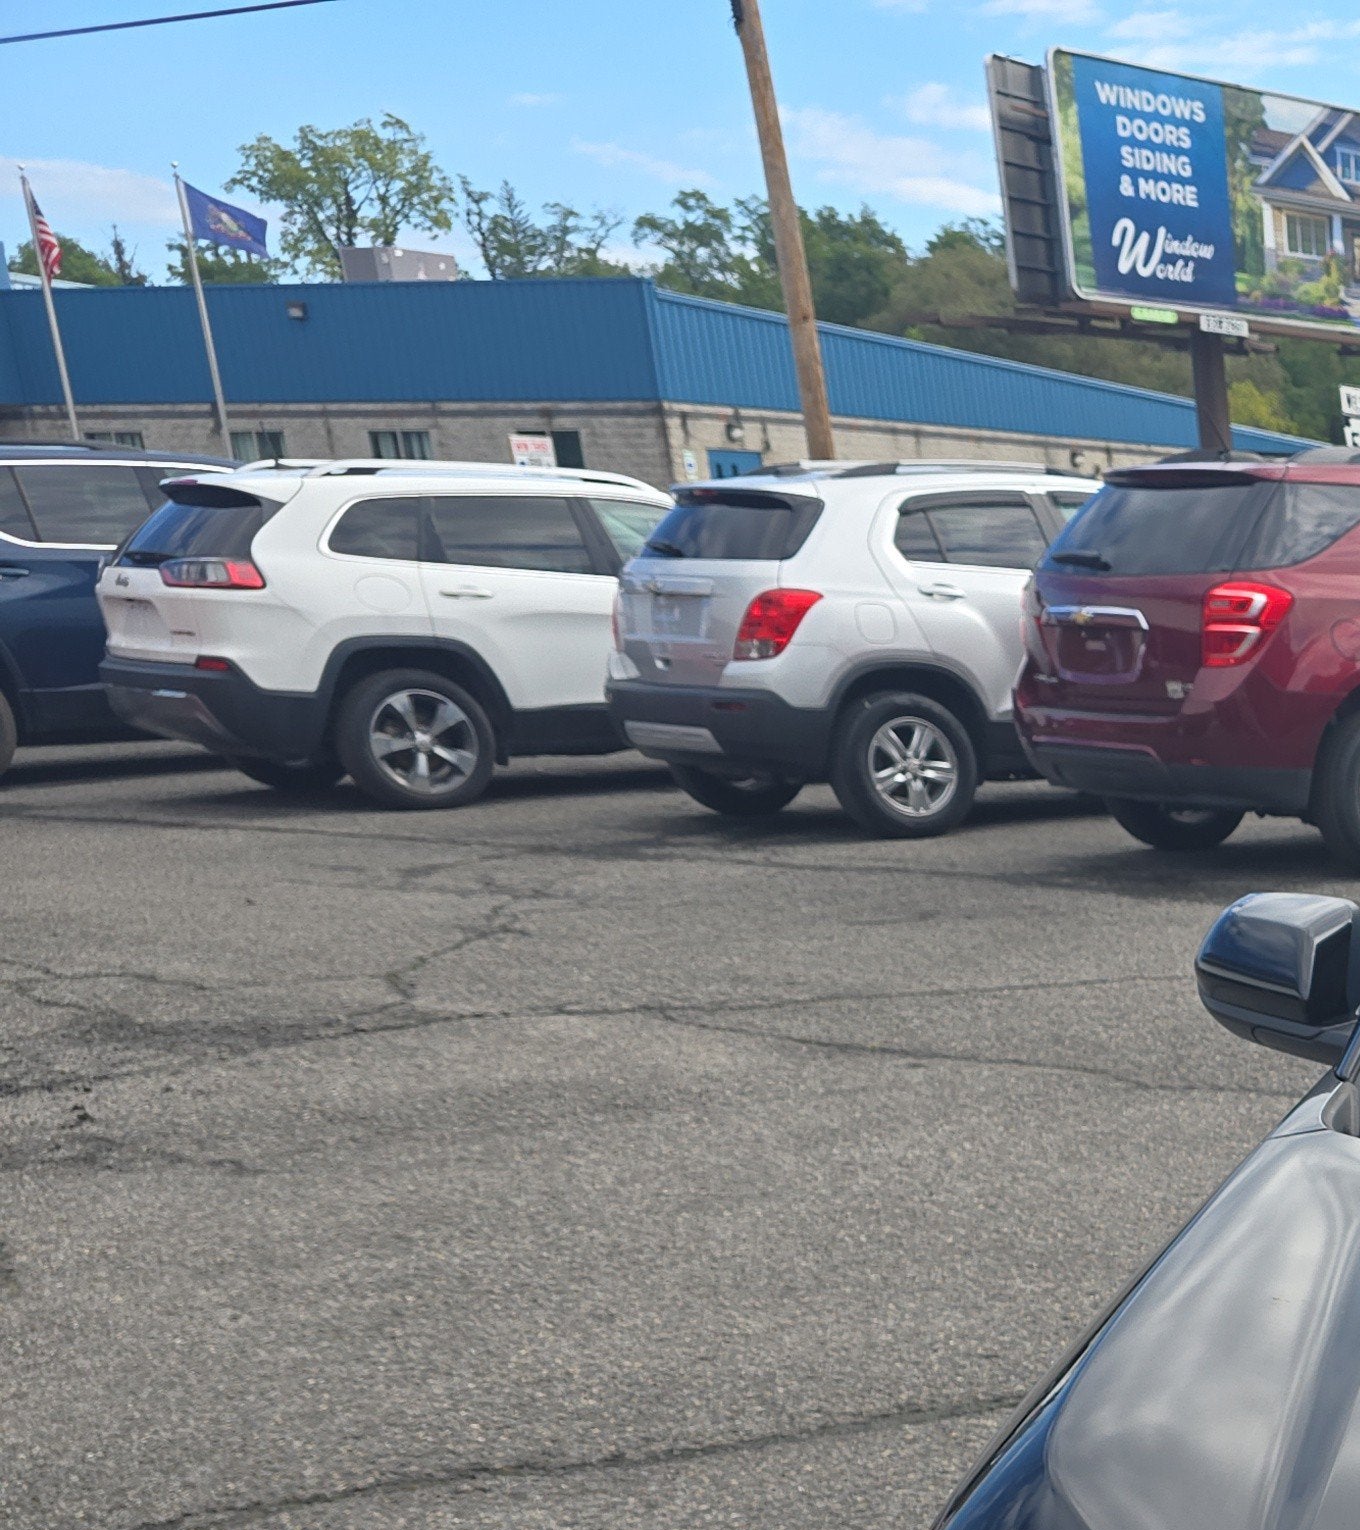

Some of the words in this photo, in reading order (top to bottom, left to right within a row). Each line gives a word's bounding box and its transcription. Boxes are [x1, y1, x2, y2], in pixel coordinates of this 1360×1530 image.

[1094, 80, 1206, 123] WINDOWS
[1115, 114, 1192, 149] DOORS
[1120, 145, 1193, 178] SIDING
[1119, 173, 1135, 198] &
[1137, 177, 1200, 208] MORE
[1111, 217, 1215, 277] Window
